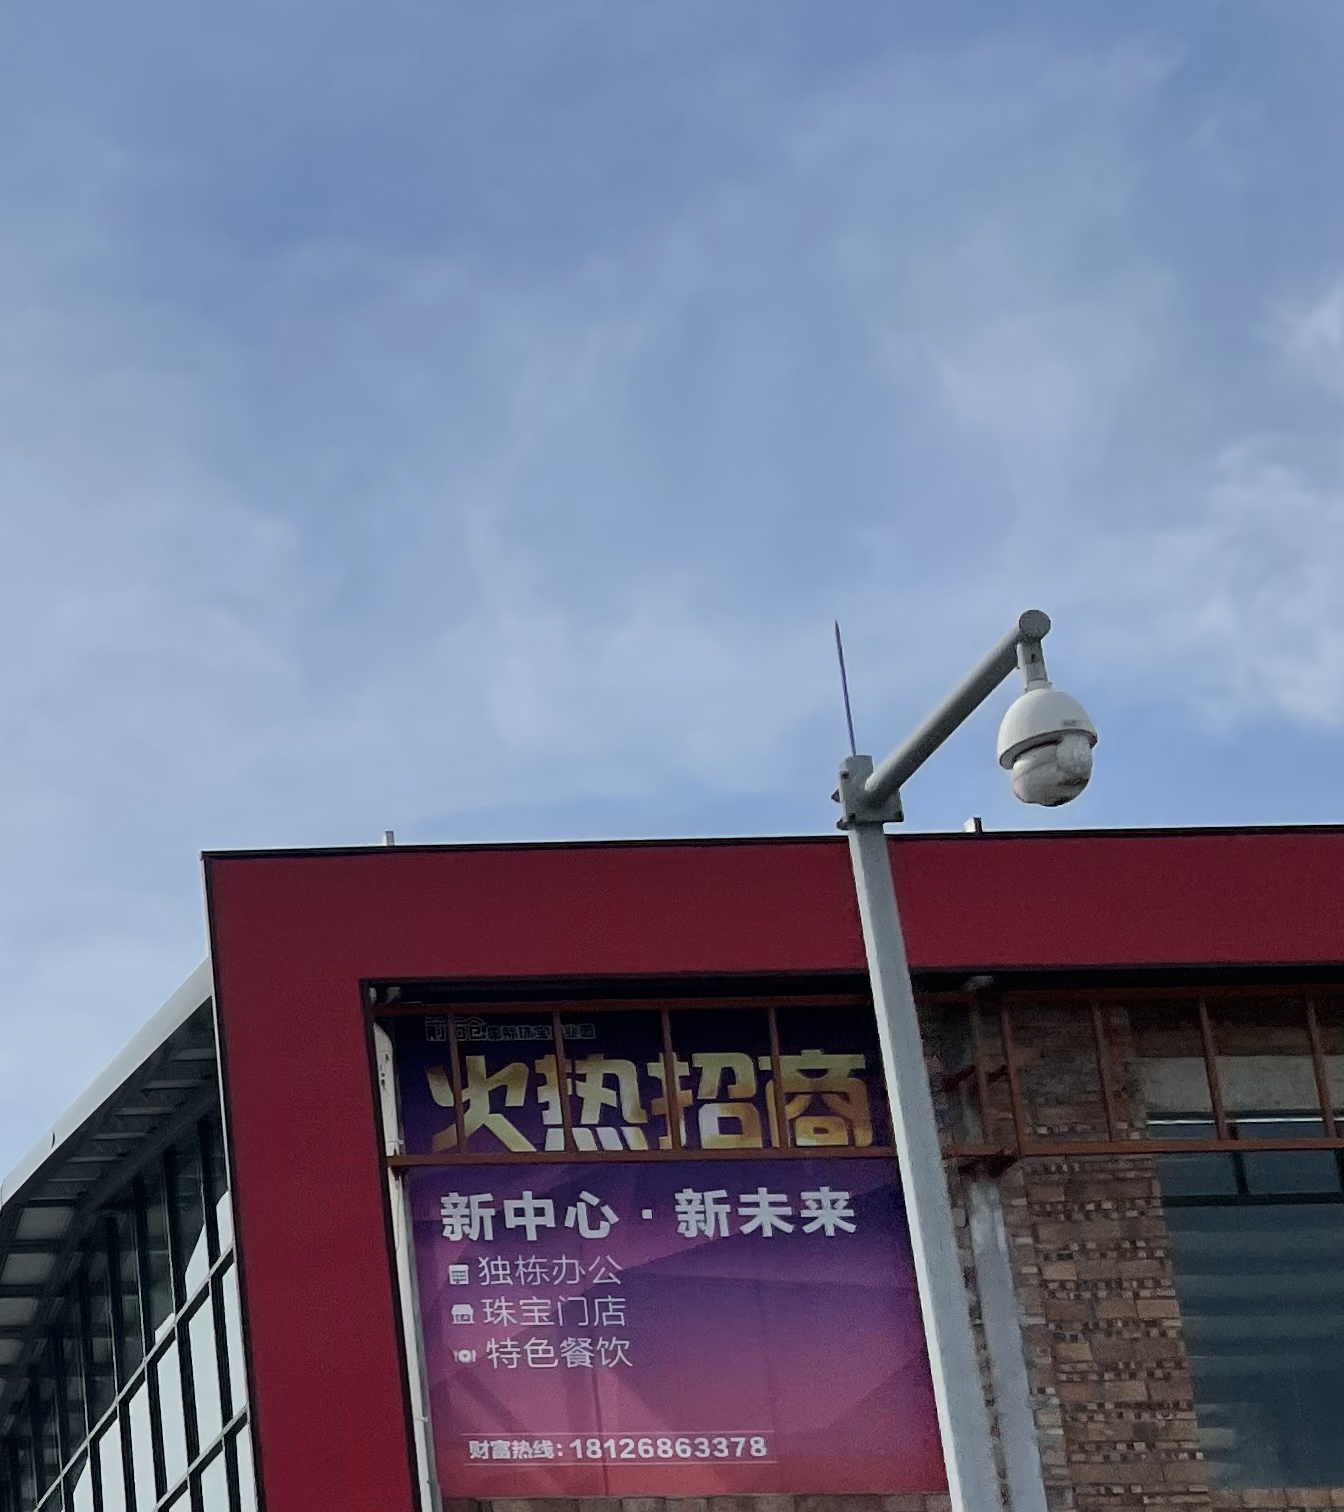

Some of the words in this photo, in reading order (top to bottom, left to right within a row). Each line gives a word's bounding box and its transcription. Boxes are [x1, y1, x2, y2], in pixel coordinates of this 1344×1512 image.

[425, 1050, 874, 1154] 火热招商
[478, 1255, 623, 1286] 独栋办公
[481, 1296, 627, 1328] 珠宝门店
[486, 1336, 633, 1370] 特色餐饮
